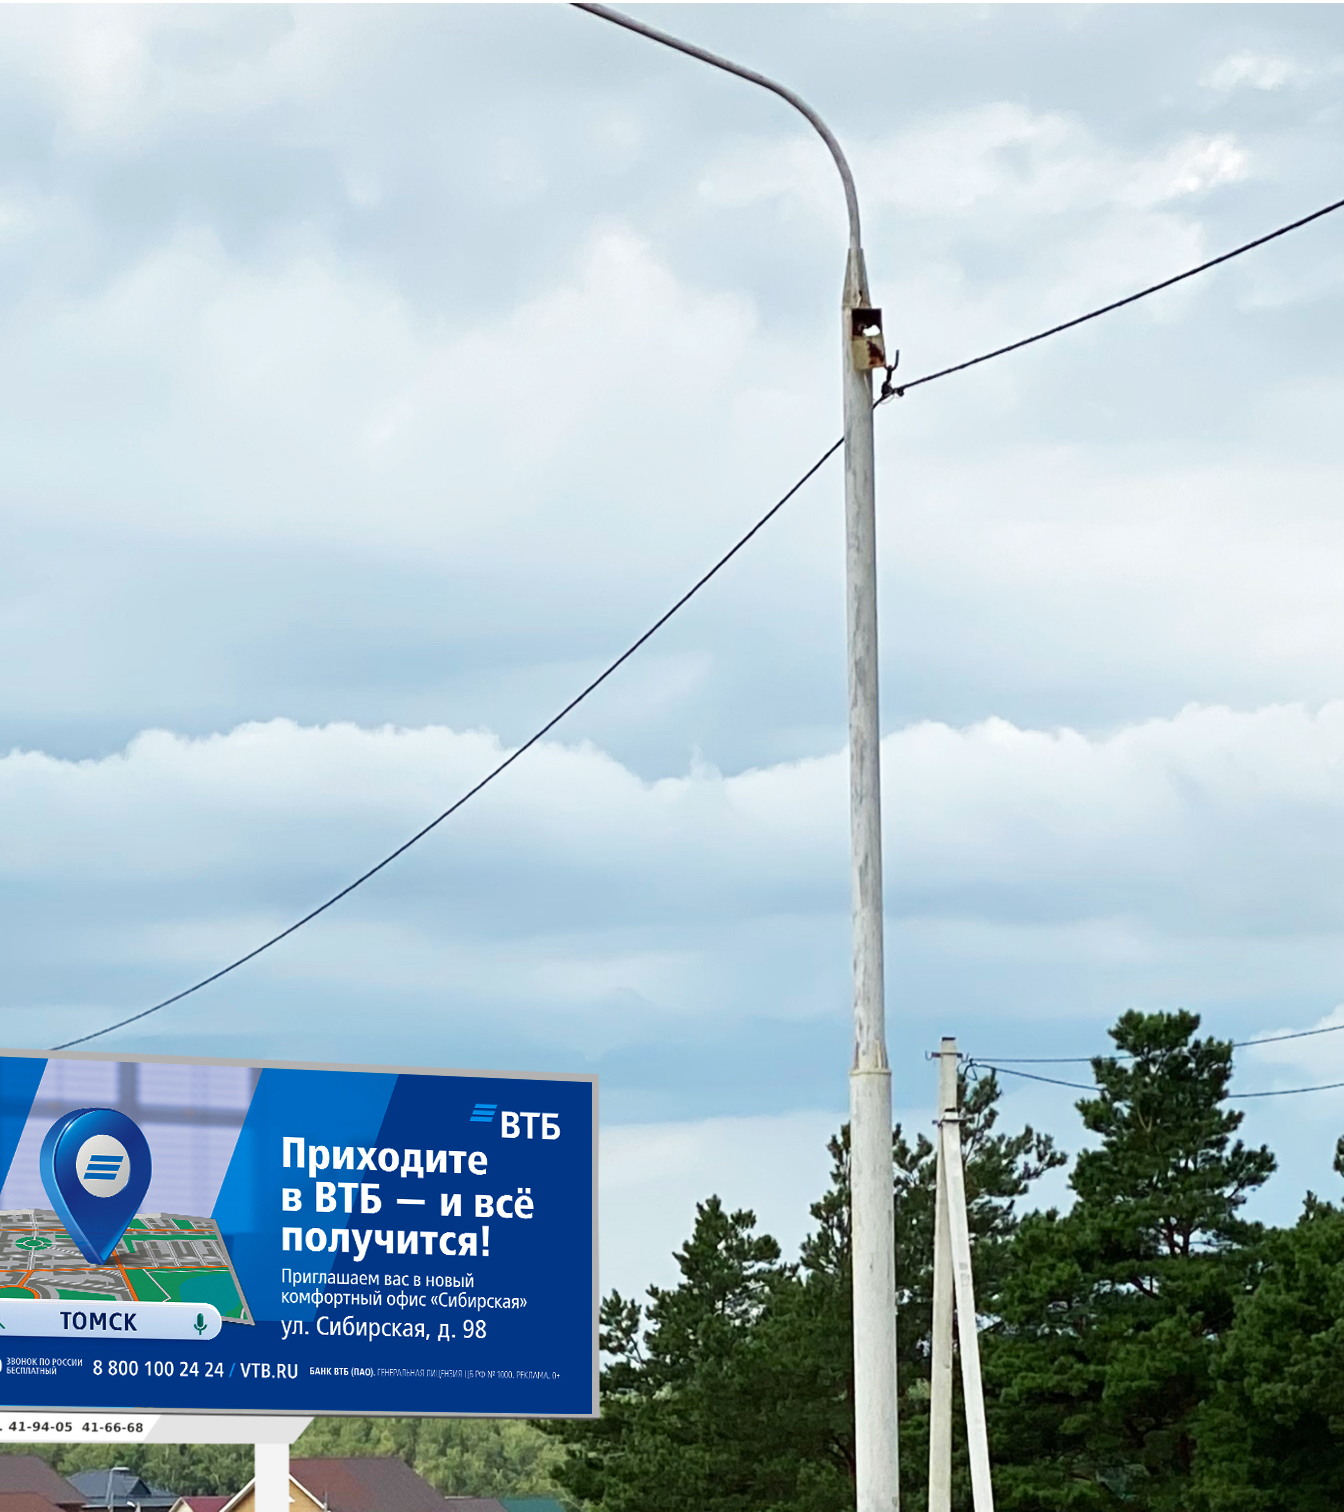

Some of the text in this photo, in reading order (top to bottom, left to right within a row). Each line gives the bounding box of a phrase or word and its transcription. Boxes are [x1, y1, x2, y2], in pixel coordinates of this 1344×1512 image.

[501, 1110, 561, 1141] ВТБ
[282, 1136, 488, 1179] Приходите
[281, 1187, 303, 1212] в
[315, 1181, 382, 1214] ВТБ
[440, 1193, 462, 1217] и
[474, 1187, 535, 1220] всё
[282, 1225, 490, 1263] получится!
[281, 1268, 475, 1288] Приглашаем вас в новый
[281, 1287, 528, 1312] комфортный офис «Сибирская»
[59, 1310, 138, 1332] ТОМСК
[280, 1315, 487, 1342] ул. Сибирская, д. 98
[6, 1357, 83, 1368] ЗВОНОК ПО РОССИИ
[6, 1365, 57, 1375] БЕСПЛАТНЫЙ
[92, 1359, 103, 1376] 8
[107, 1359, 139, 1377] 800
[144, 1360, 175, 1377] 100
[179, 1361, 200, 1378] 24
[204, 1361, 225, 1378] 24
[239, 1362, 298, 1380] VTB.RU
[309, 1366, 332, 1376] БАНК
[333, 1367, 349, 1376] ВТБ
[350, 1366, 376, 1378] (ПАО).
[377, 1368, 425, 1377] ГЕНЕРАЛЬНАЯ
[8, 1421, 73, 1433] 41-94-05
[81, 1422, 144, 1433] 41-66-68
